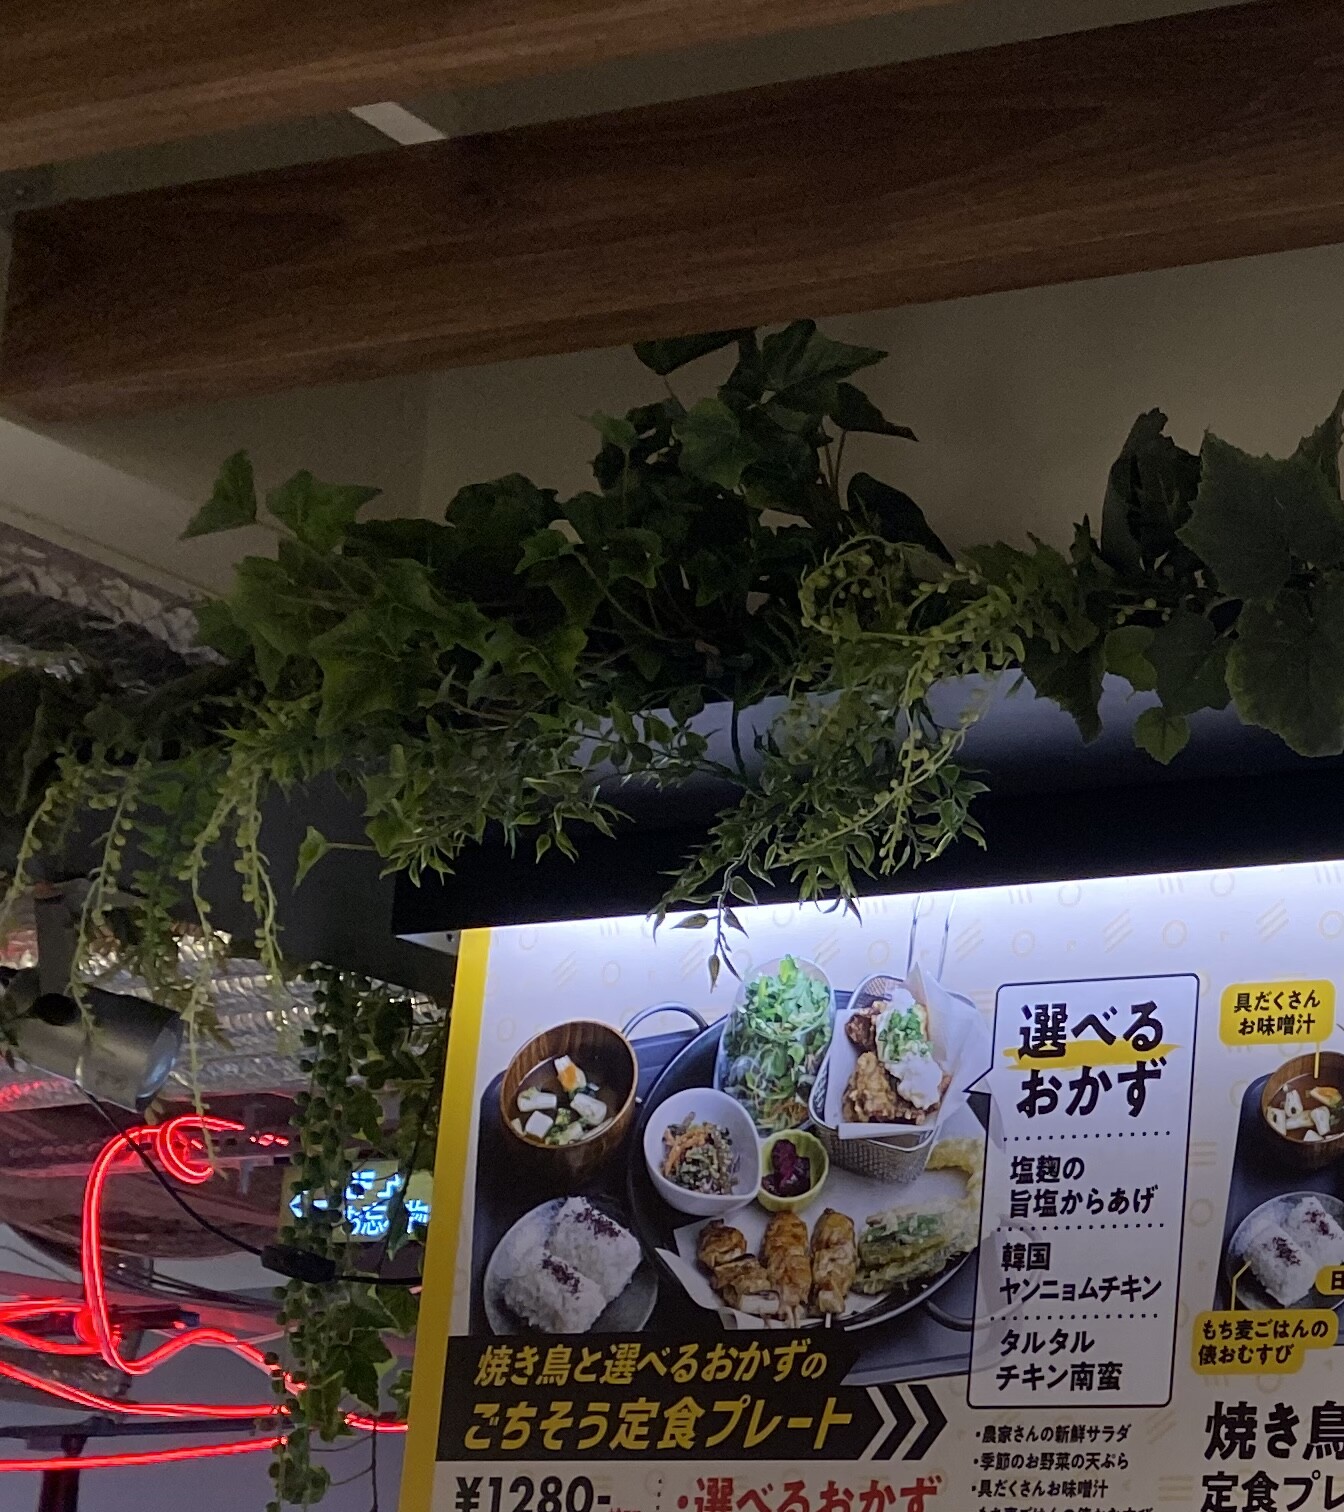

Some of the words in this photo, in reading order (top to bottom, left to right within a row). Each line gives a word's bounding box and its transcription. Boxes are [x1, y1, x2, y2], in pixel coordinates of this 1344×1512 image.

[1233, 988, 1321, 1013] 具だくさん
[1018, 1001, 1164, 1058] 選べる
[1237, 1013, 1316, 1036] お味噌汁
[1016, 1057, 1168, 1118] おかず
[1010, 1156, 1085, 1184] 塩麹の
[1009, 1186, 1159, 1219] 旨塩からあげ
[1001, 1242, 1052, 1271] 韓国
[999, 1275, 1162, 1305] ヤンニョムチキン
[1000, 1328, 1095, 1356] タルタル
[1201, 1319, 1329, 1340] もち麦ごはんの
[473, 1338, 827, 1387] 焼き鳥と選べるおかずの
[1198, 1342, 1294, 1366] 俵おむすび
[996, 1361, 1123, 1392] チキン南蛮
[464, 1394, 852, 1450] ごちそう定食プレート
